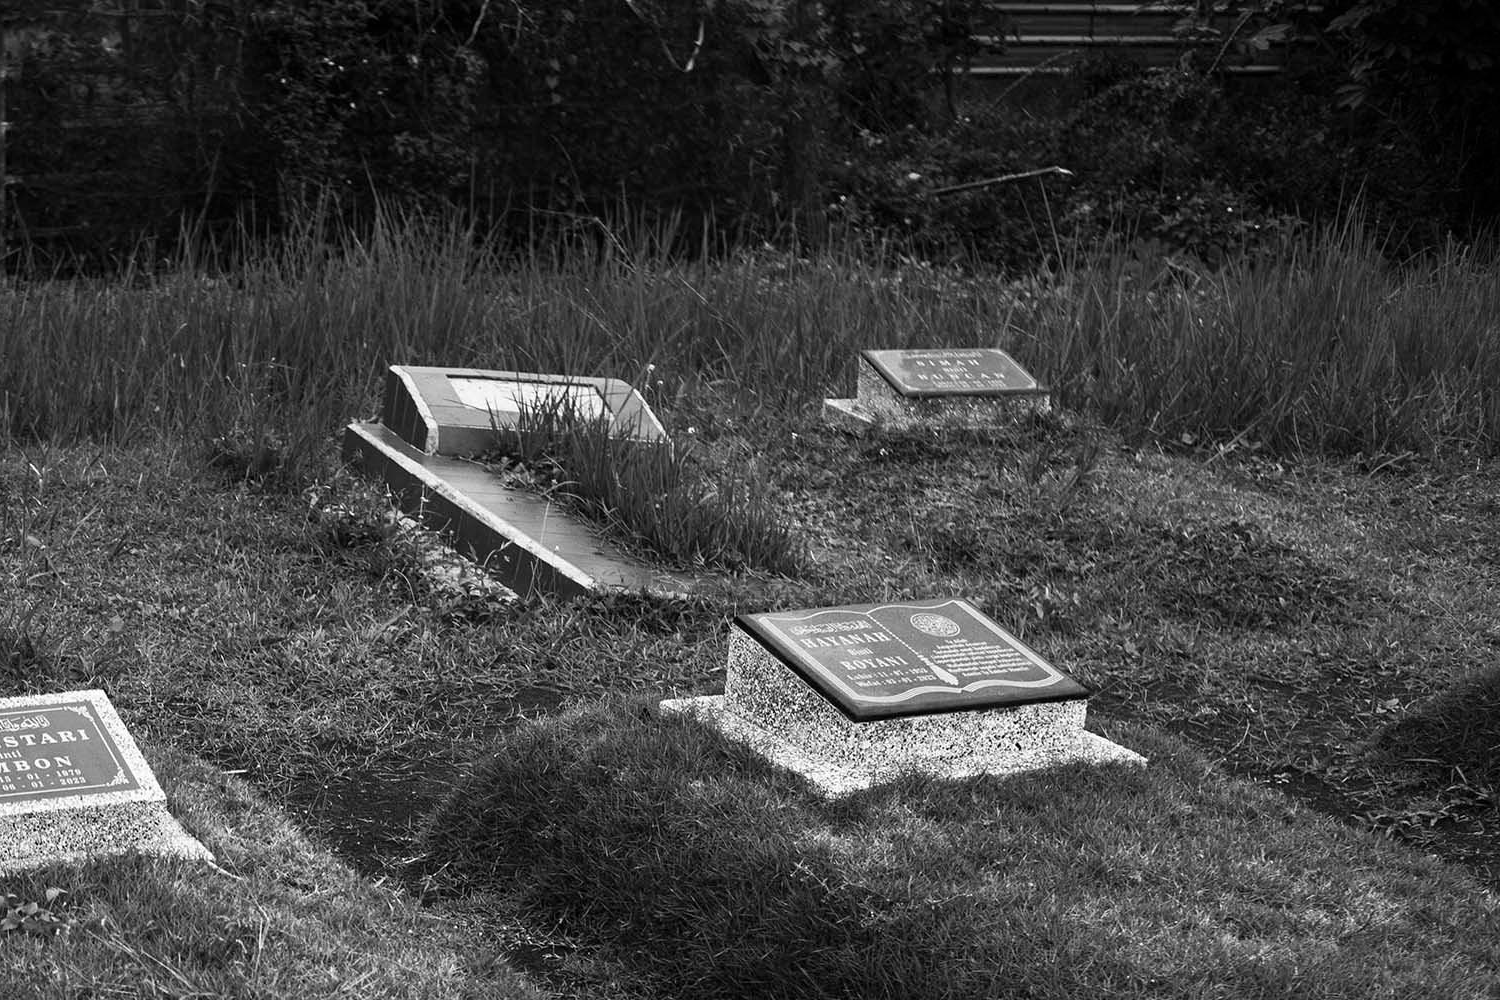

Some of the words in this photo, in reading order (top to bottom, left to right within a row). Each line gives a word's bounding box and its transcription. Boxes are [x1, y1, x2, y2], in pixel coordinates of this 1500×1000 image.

[800, 631, 893, 649] HAYANAH
[840, 655, 910, 671] ROYANI
[59, 776, 87, 786] 2023
